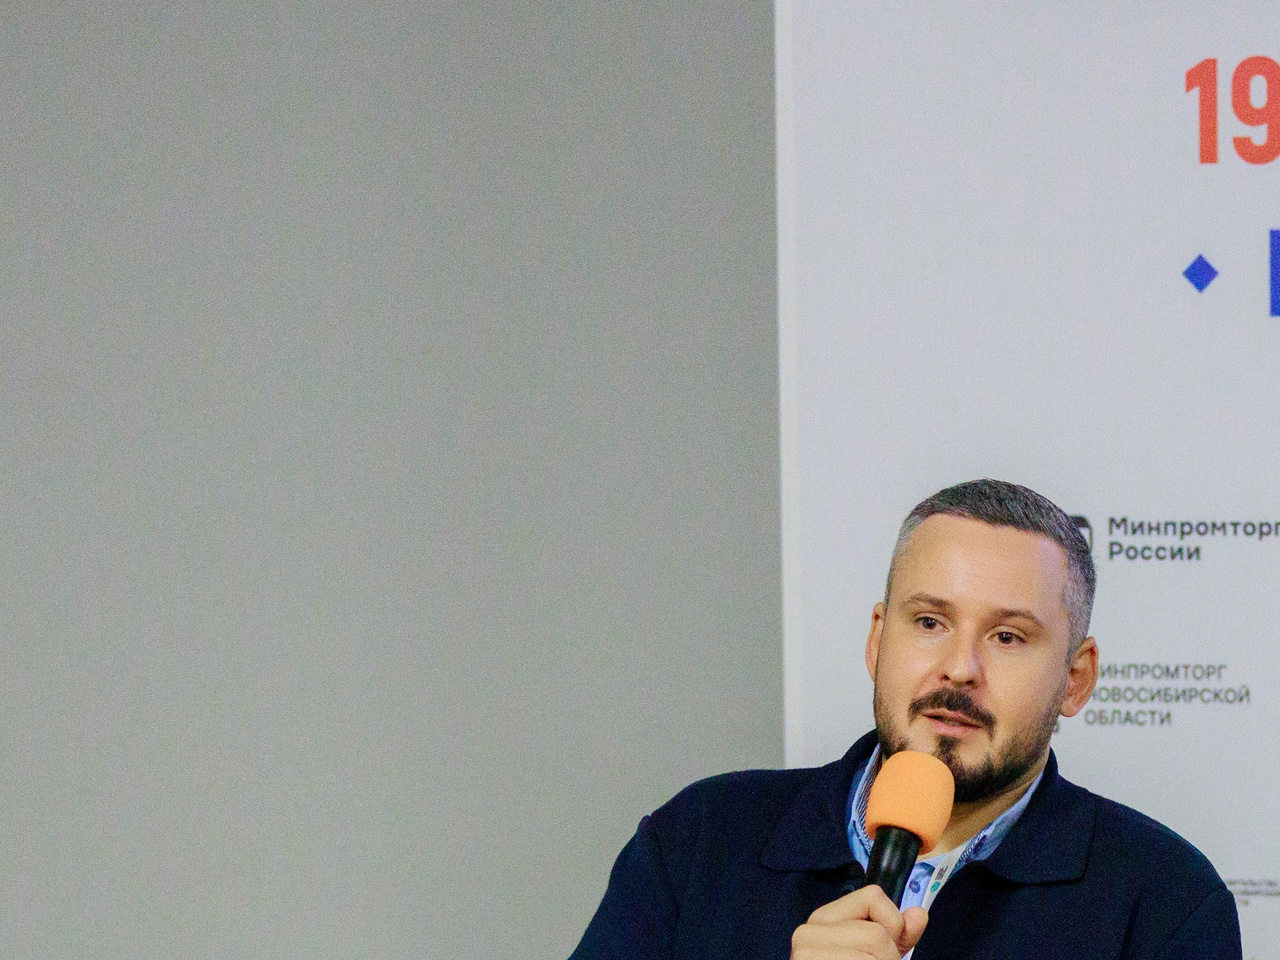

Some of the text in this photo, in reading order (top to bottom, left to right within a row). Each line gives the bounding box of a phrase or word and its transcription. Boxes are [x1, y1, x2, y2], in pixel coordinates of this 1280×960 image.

[1109, 538, 1200, 560] России
[1099, 663, 1227, 680] ИНПРОМТОРГ
[1083, 708, 1172, 726] ОБЛАСТИ
